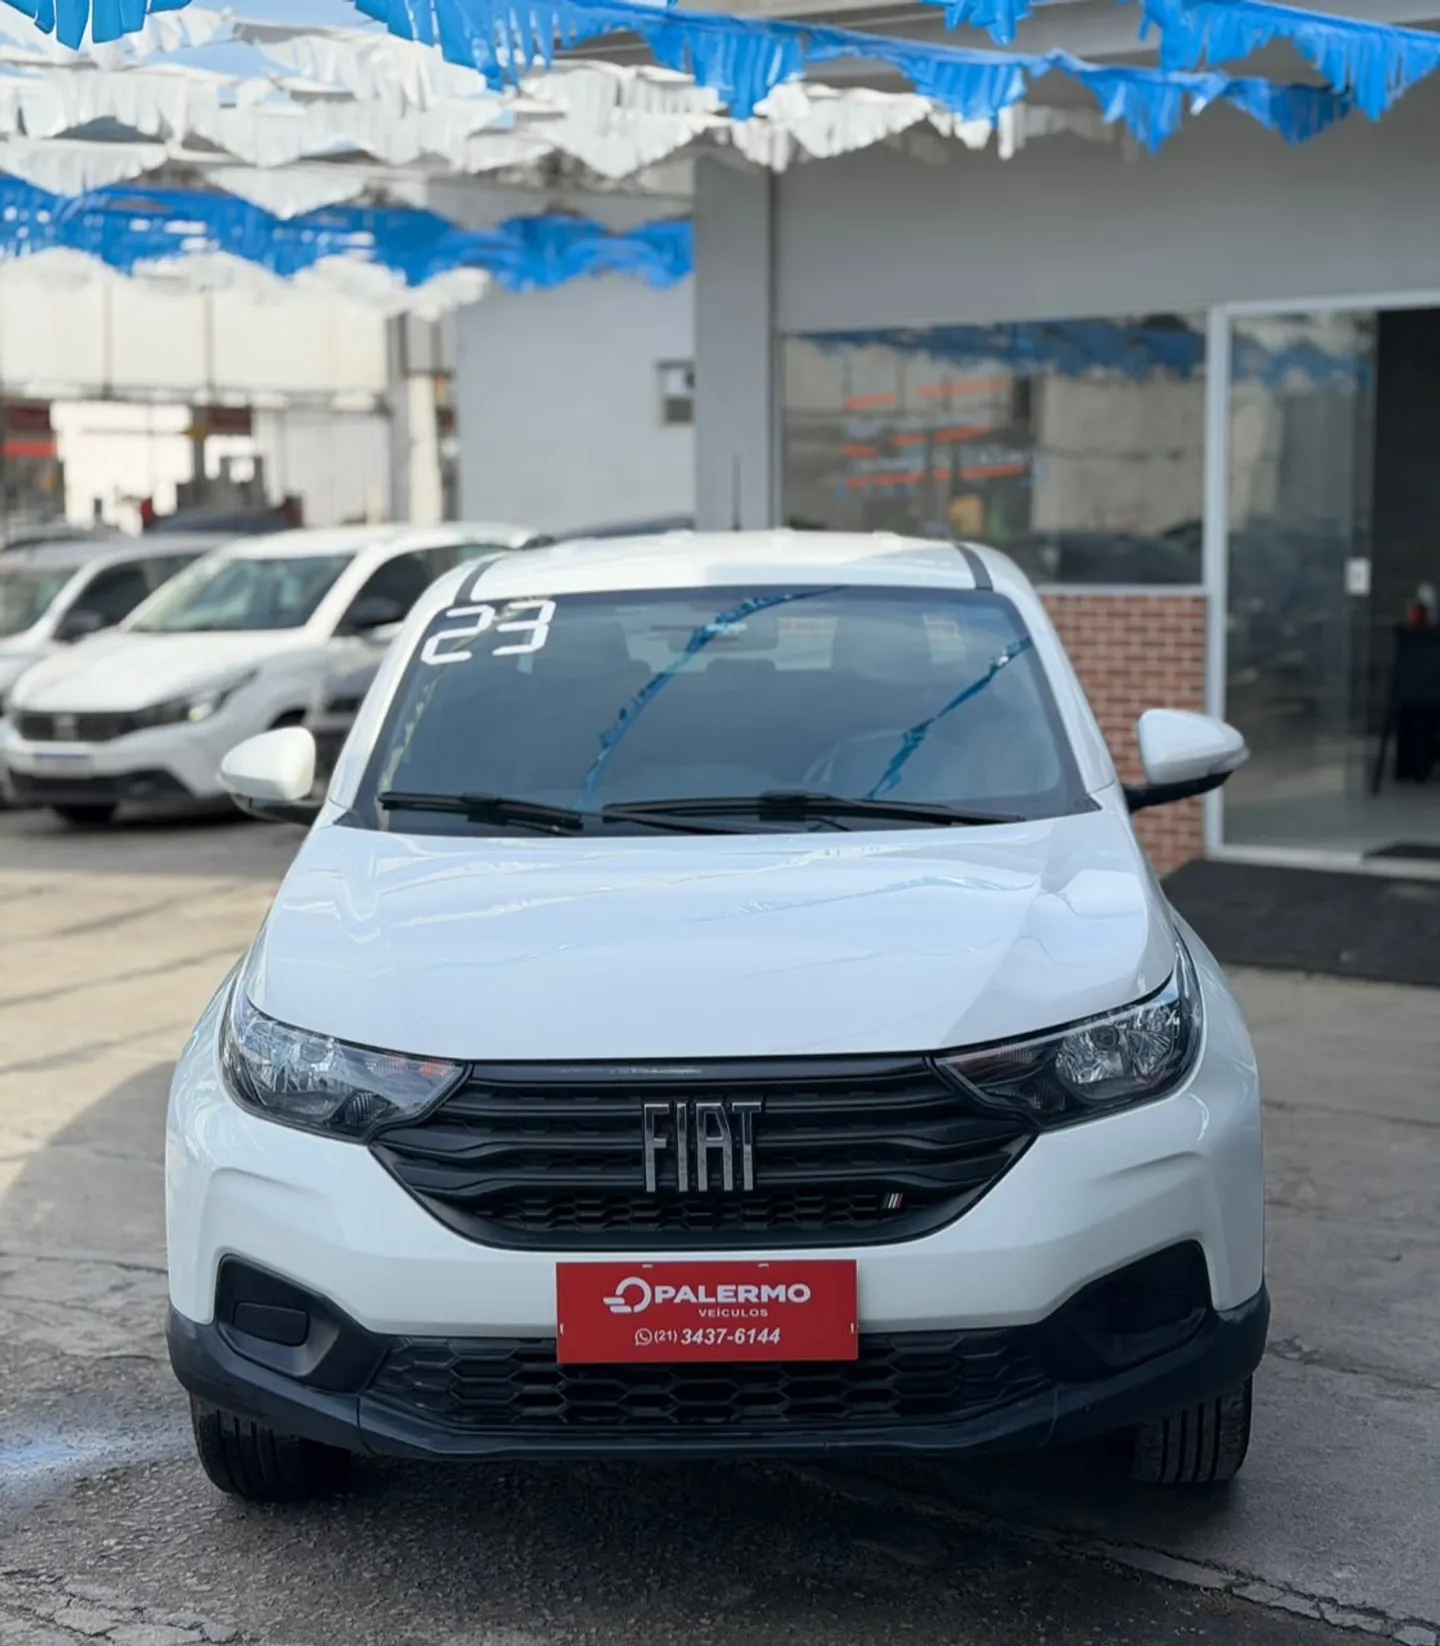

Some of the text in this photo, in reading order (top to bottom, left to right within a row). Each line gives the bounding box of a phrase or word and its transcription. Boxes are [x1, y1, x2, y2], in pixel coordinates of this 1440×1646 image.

[420, 600, 556, 665] 23
[644, 1102, 761, 1192] FIAT
[656, 1284, 811, 1303] PALERMO
[698, 1308, 769, 1318] VEÍCULOS
[654, 1327, 781, 1345] (21) 3437-6144
